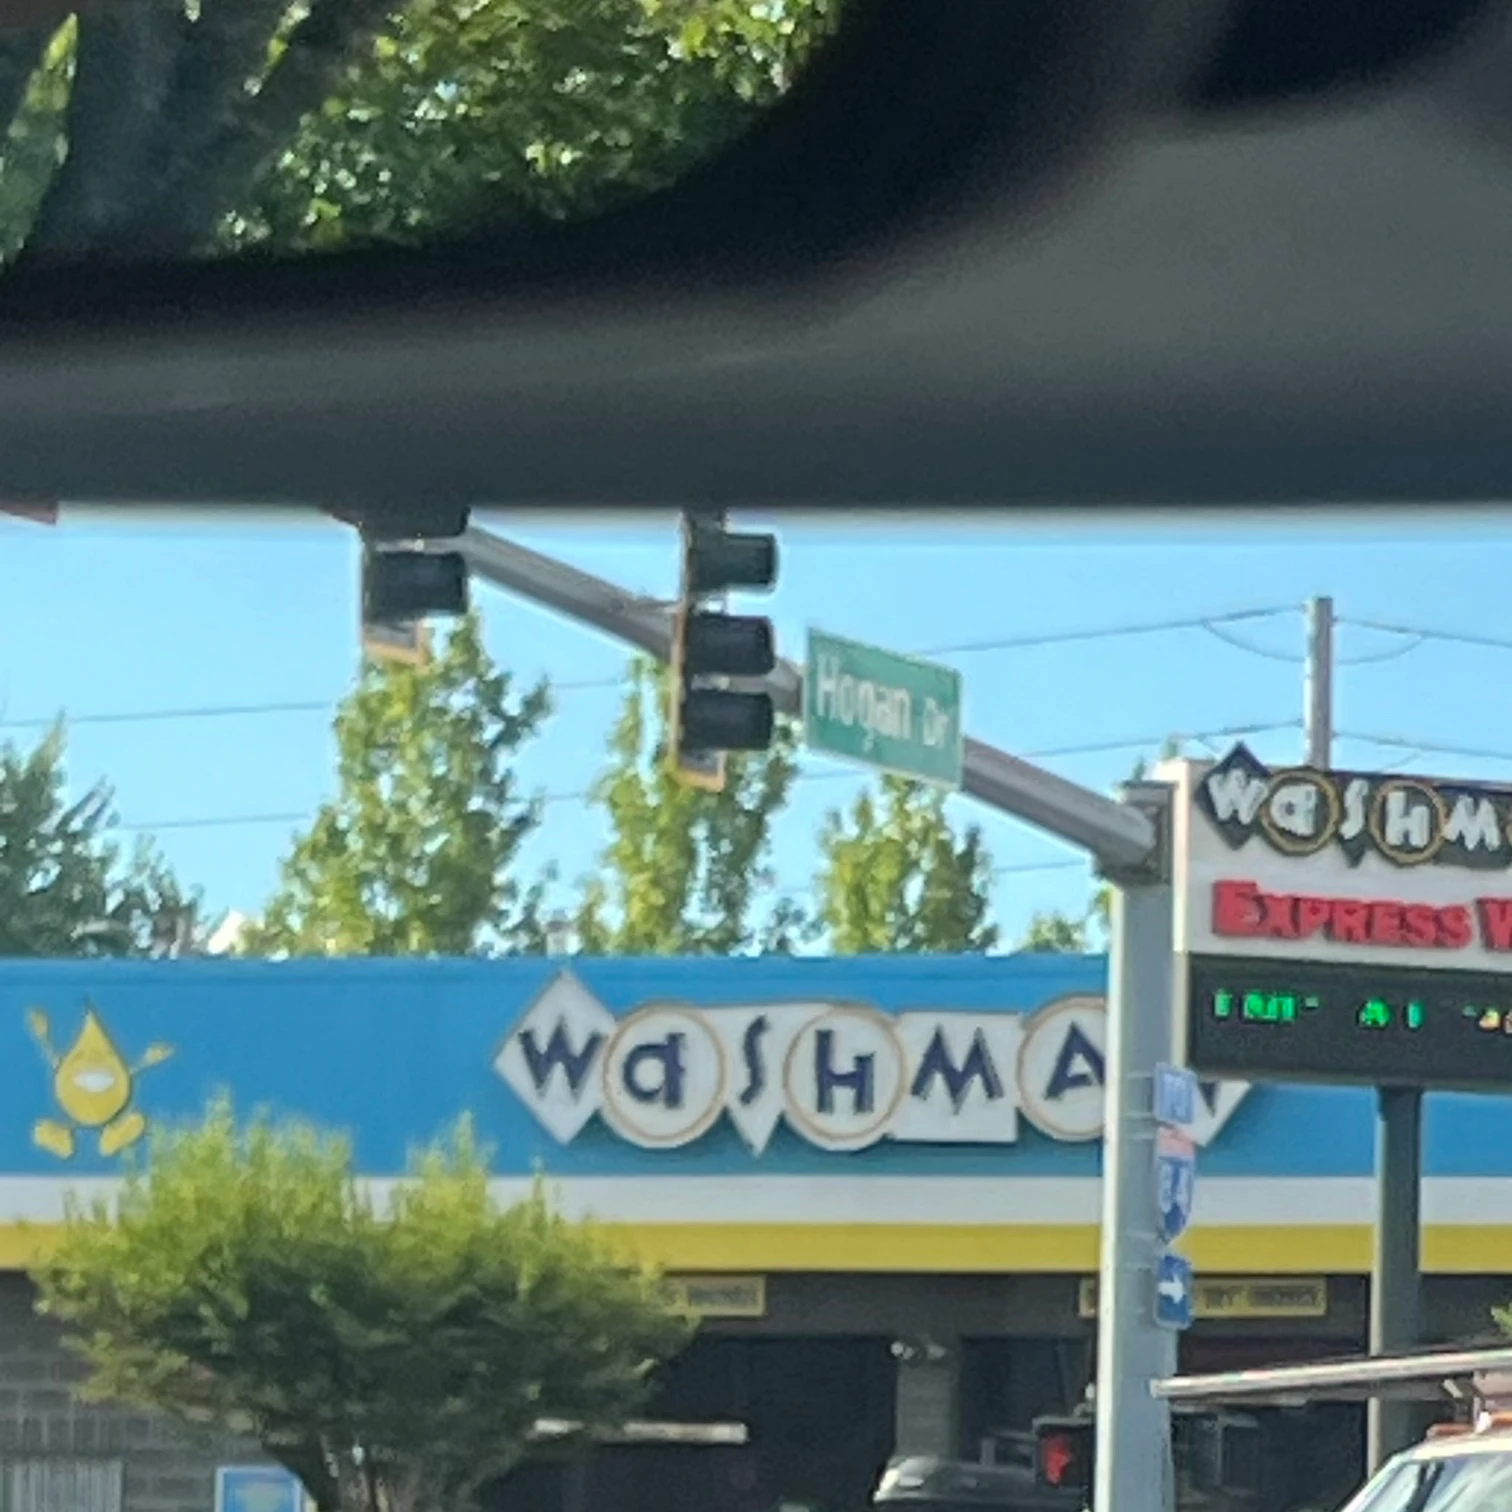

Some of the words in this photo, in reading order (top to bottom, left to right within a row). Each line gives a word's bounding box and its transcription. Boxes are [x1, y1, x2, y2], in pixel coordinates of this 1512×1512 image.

[817, 652, 911, 753] Hogan
[923, 697, 949, 747] Dr
[1213, 880, 1472, 950] EXPRESS
[518, 1013, 1218, 1118] WaSHMA
